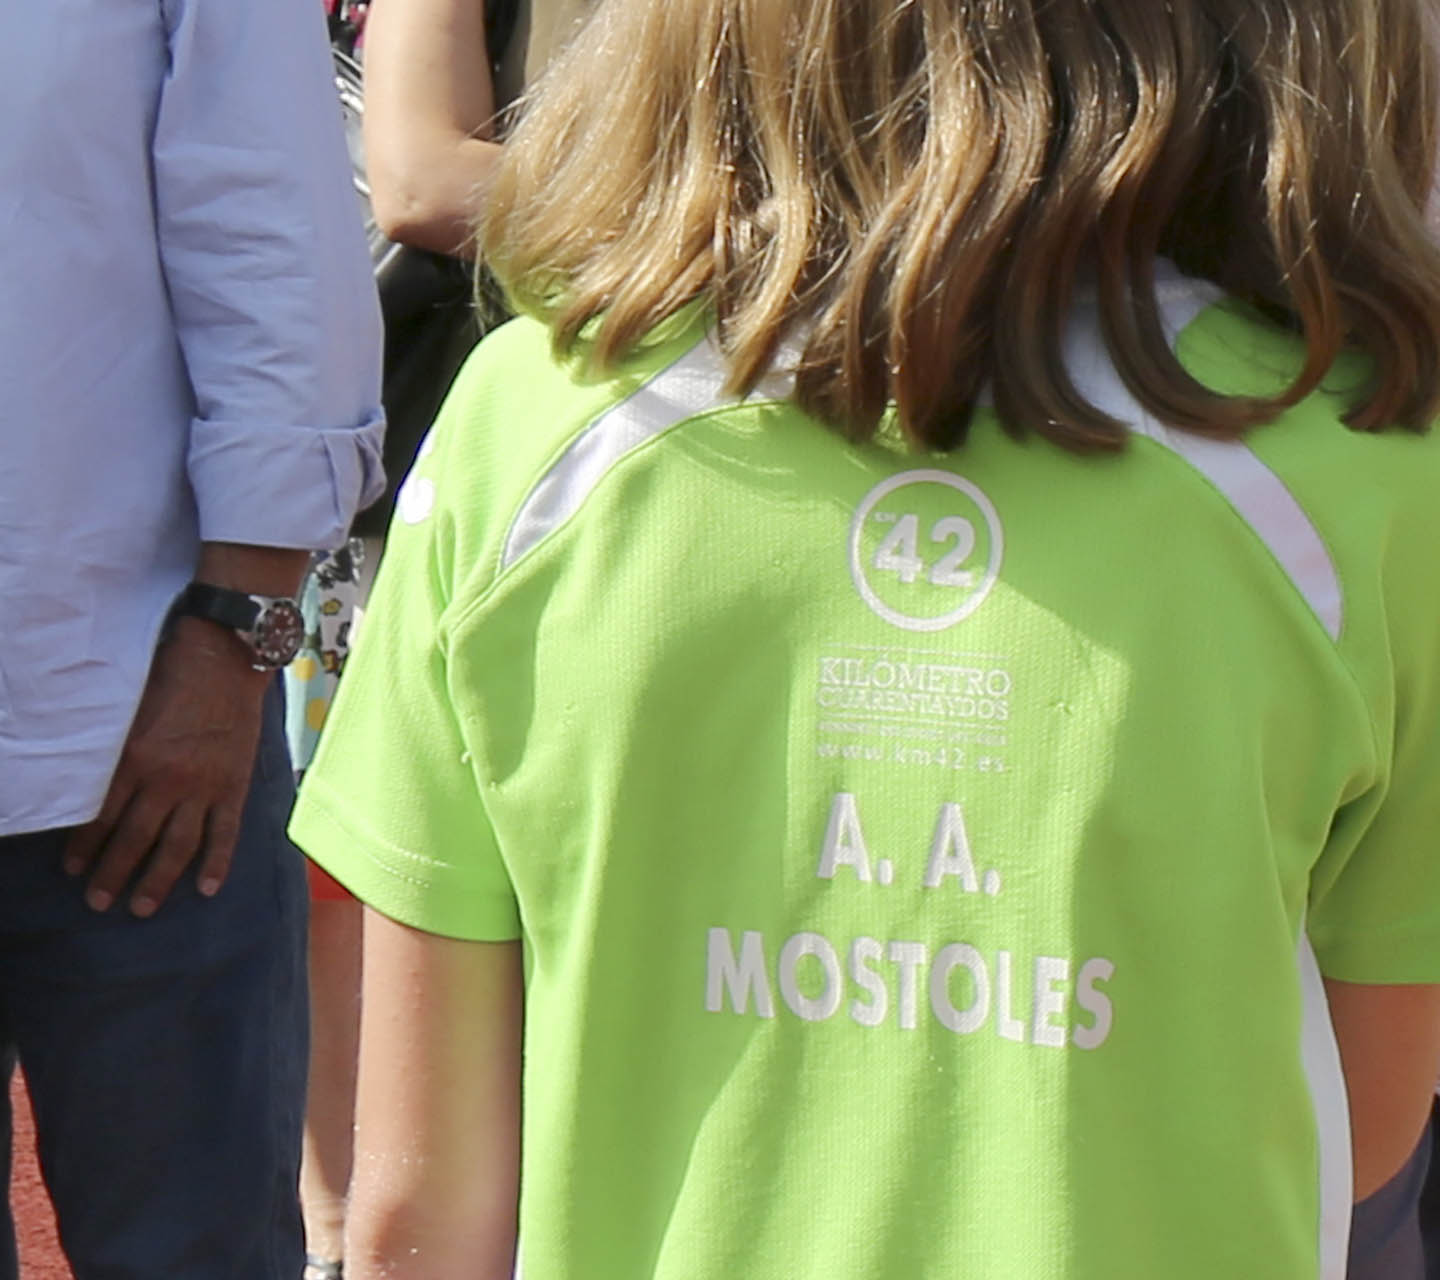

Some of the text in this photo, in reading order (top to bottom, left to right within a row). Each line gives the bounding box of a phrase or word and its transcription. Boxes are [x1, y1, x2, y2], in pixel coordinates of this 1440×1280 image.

[871, 513, 975, 587] 42
[819, 652, 1012, 697] KILÓMETRO
[817, 791, 1003, 896] A. A.
[705, 926, 1116, 1051] MOSTOLES
